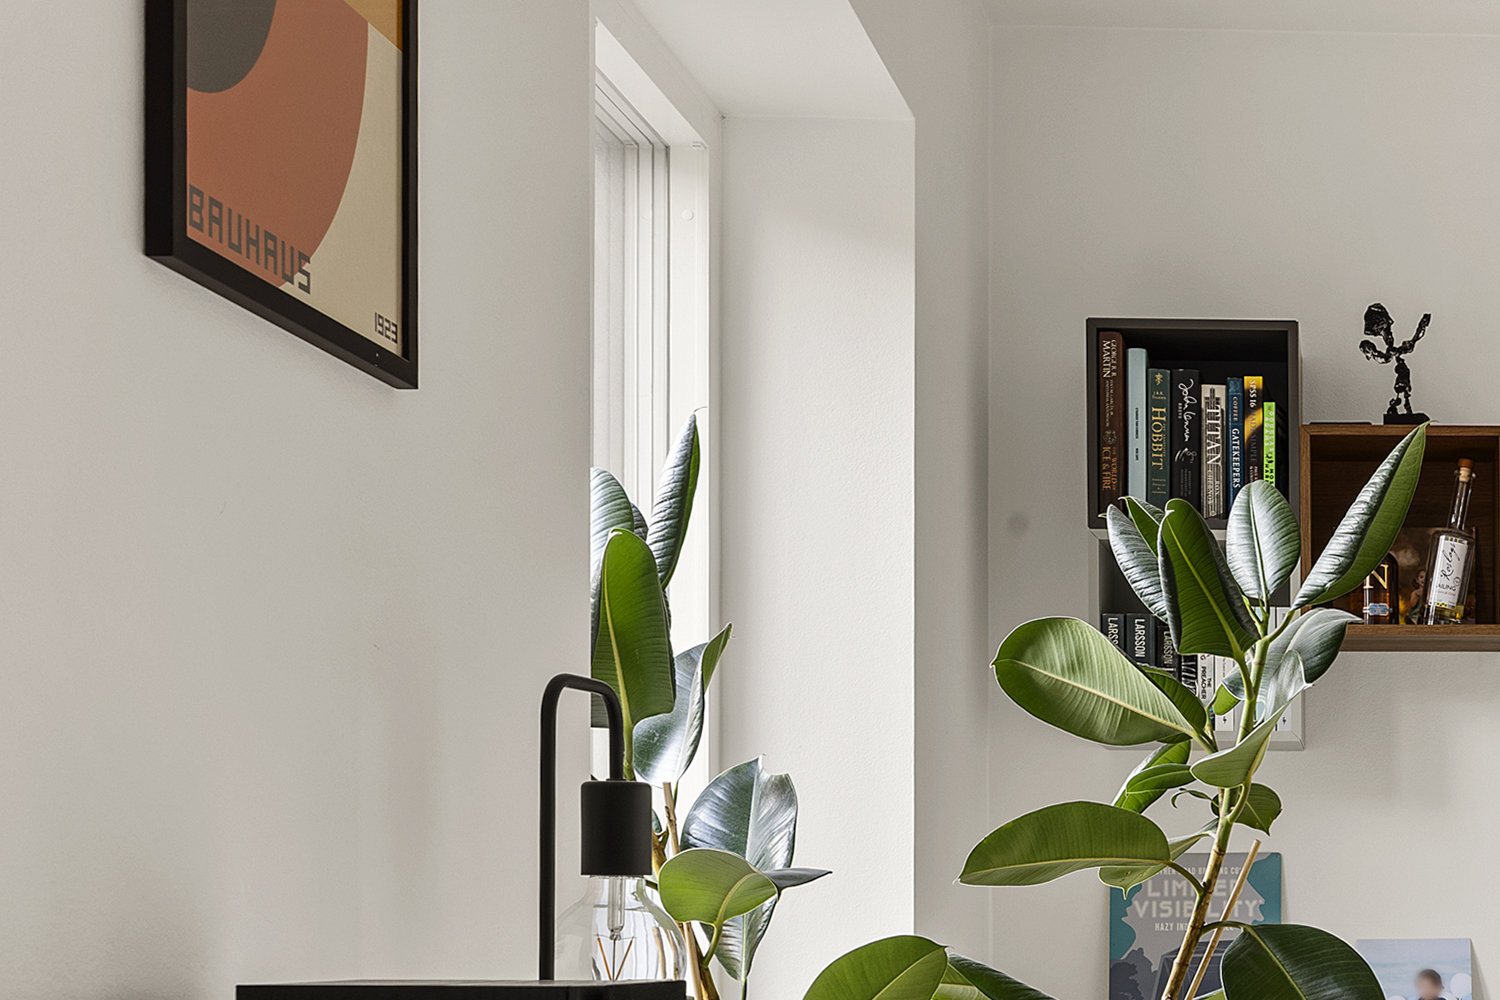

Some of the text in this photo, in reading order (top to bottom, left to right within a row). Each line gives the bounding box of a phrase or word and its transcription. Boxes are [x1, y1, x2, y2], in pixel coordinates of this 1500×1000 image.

[188, 183, 311, 295] BAUHAUS
[374, 311, 398, 344] 1923
[1102, 340, 1111, 378] MARTIN
[1249, 380, 1257, 398] SPSS
[1249, 399, 1257, 408] 16
[1152, 407, 1167, 470] HOBBIT
[1206, 404, 1221, 466] TITAN
[1102, 446, 1112, 490] ICE & FIRE
[1232, 428, 1241, 488] GATEKEEPERS
[1108, 617, 1118, 644] LARSS
[1135, 618, 1145, 657] LARSSON
[1163, 631, 1173, 665] LARSSON
[1155, 923, 1174, 932] HAZY
